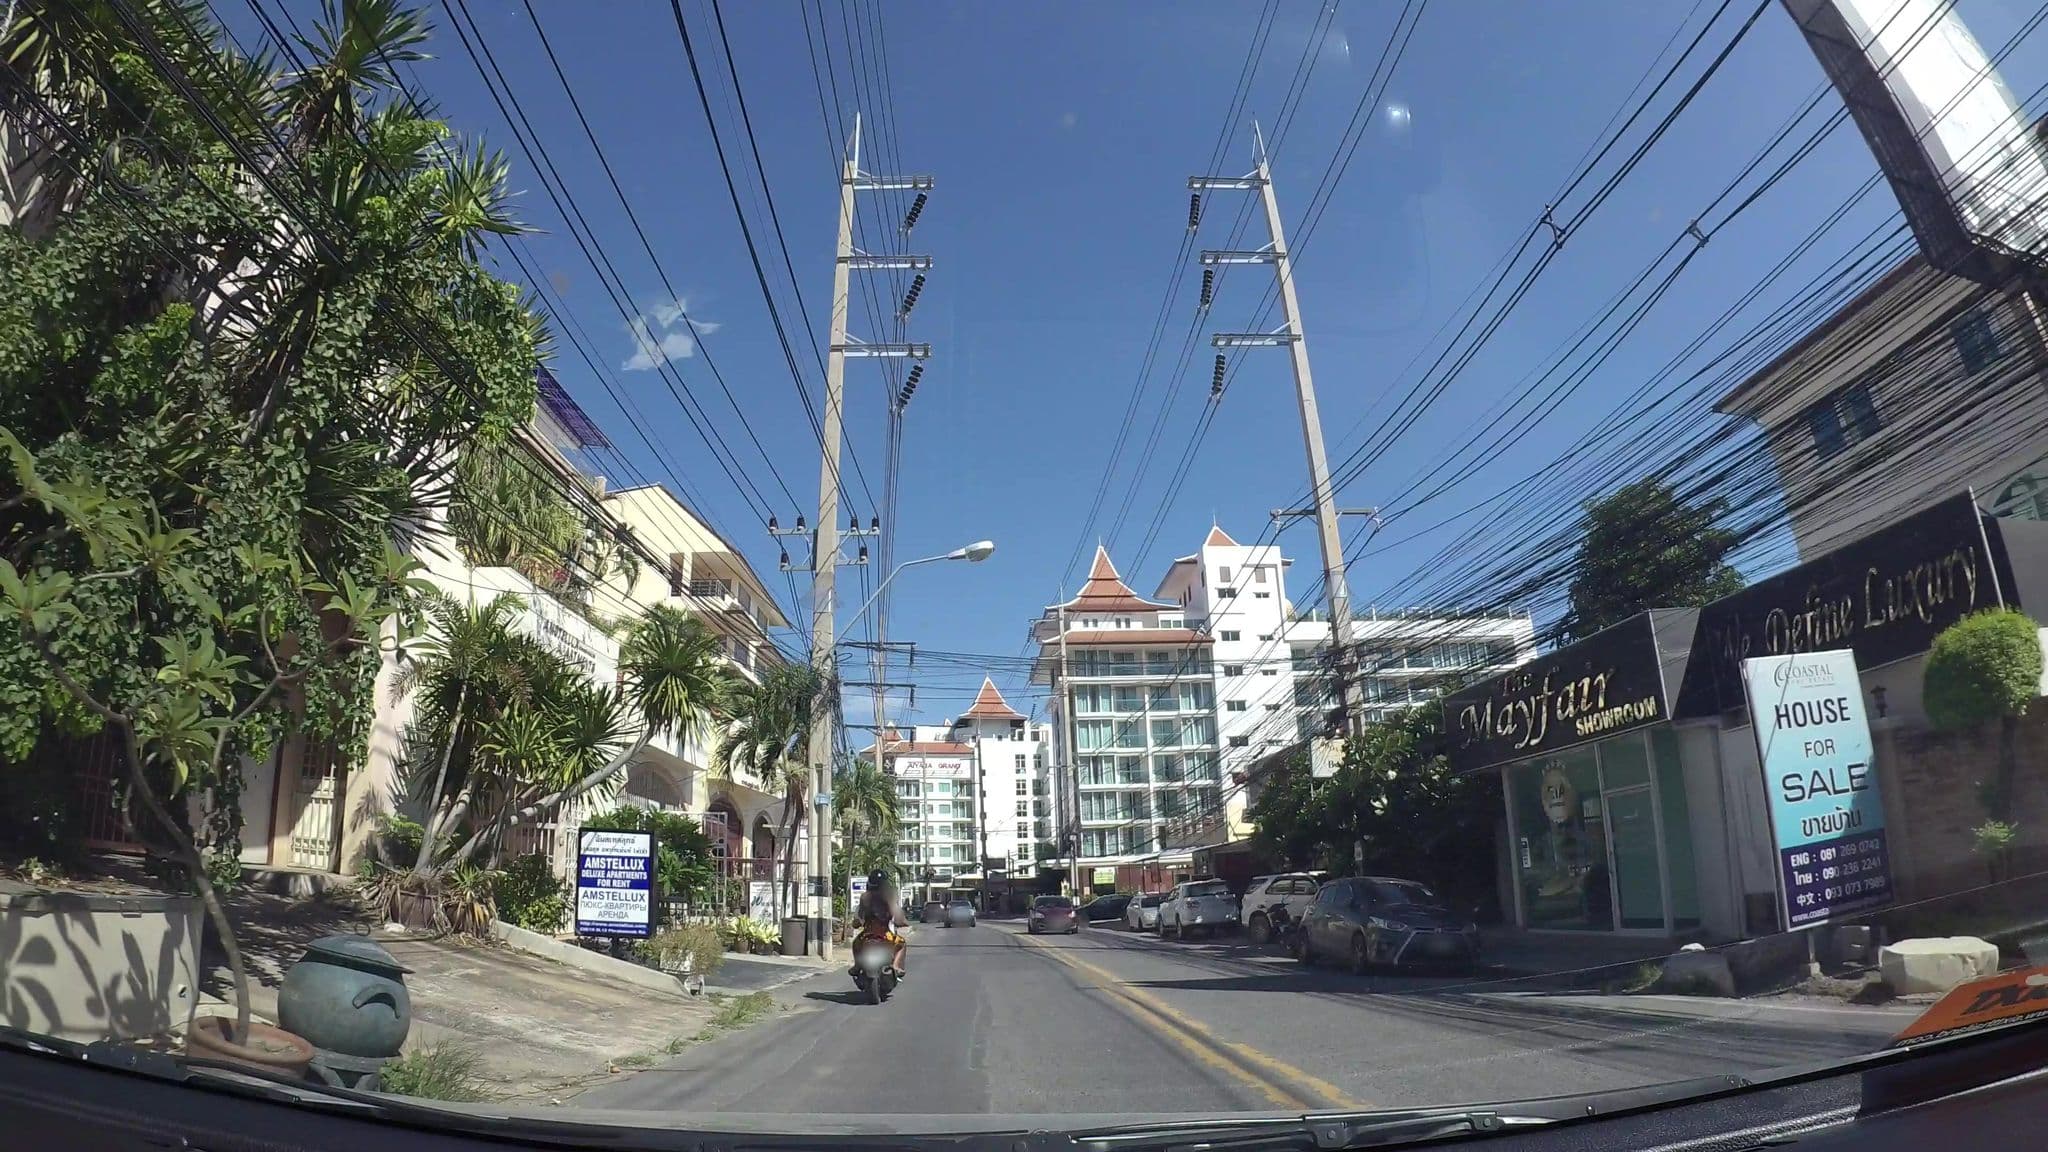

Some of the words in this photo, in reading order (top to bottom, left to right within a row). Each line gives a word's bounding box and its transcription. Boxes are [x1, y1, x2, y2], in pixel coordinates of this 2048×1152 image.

[1864, 545, 1977, 629] Luxury
[1459, 664, 1615, 750] Mayfair
[1575, 695, 1658, 737] SHOWROOM
[1774, 697, 1851, 730] HOUSE
[1804, 738, 1836, 758] FOR
[1782, 762, 1869, 802] SALE
[1802, 806, 1863, 837] ขายบ้าน
[584, 857, 645, 870] AMSTELLUX
[1790, 852, 1810, 867] ENG
[1820, 847, 1837, 861] 081
[581, 869, 606, 878] DELUXE
[606, 870, 648, 880] APARTMENTS
[1822, 866, 1840, 880] 090
[597, 879, 611, 887] FOR
[612, 879, 631, 888] RENT
[582, 890, 646, 902] AMSTELLUX
[1796, 891, 1816, 907] 中文
[597, 910, 629, 919] АРЕНДА
